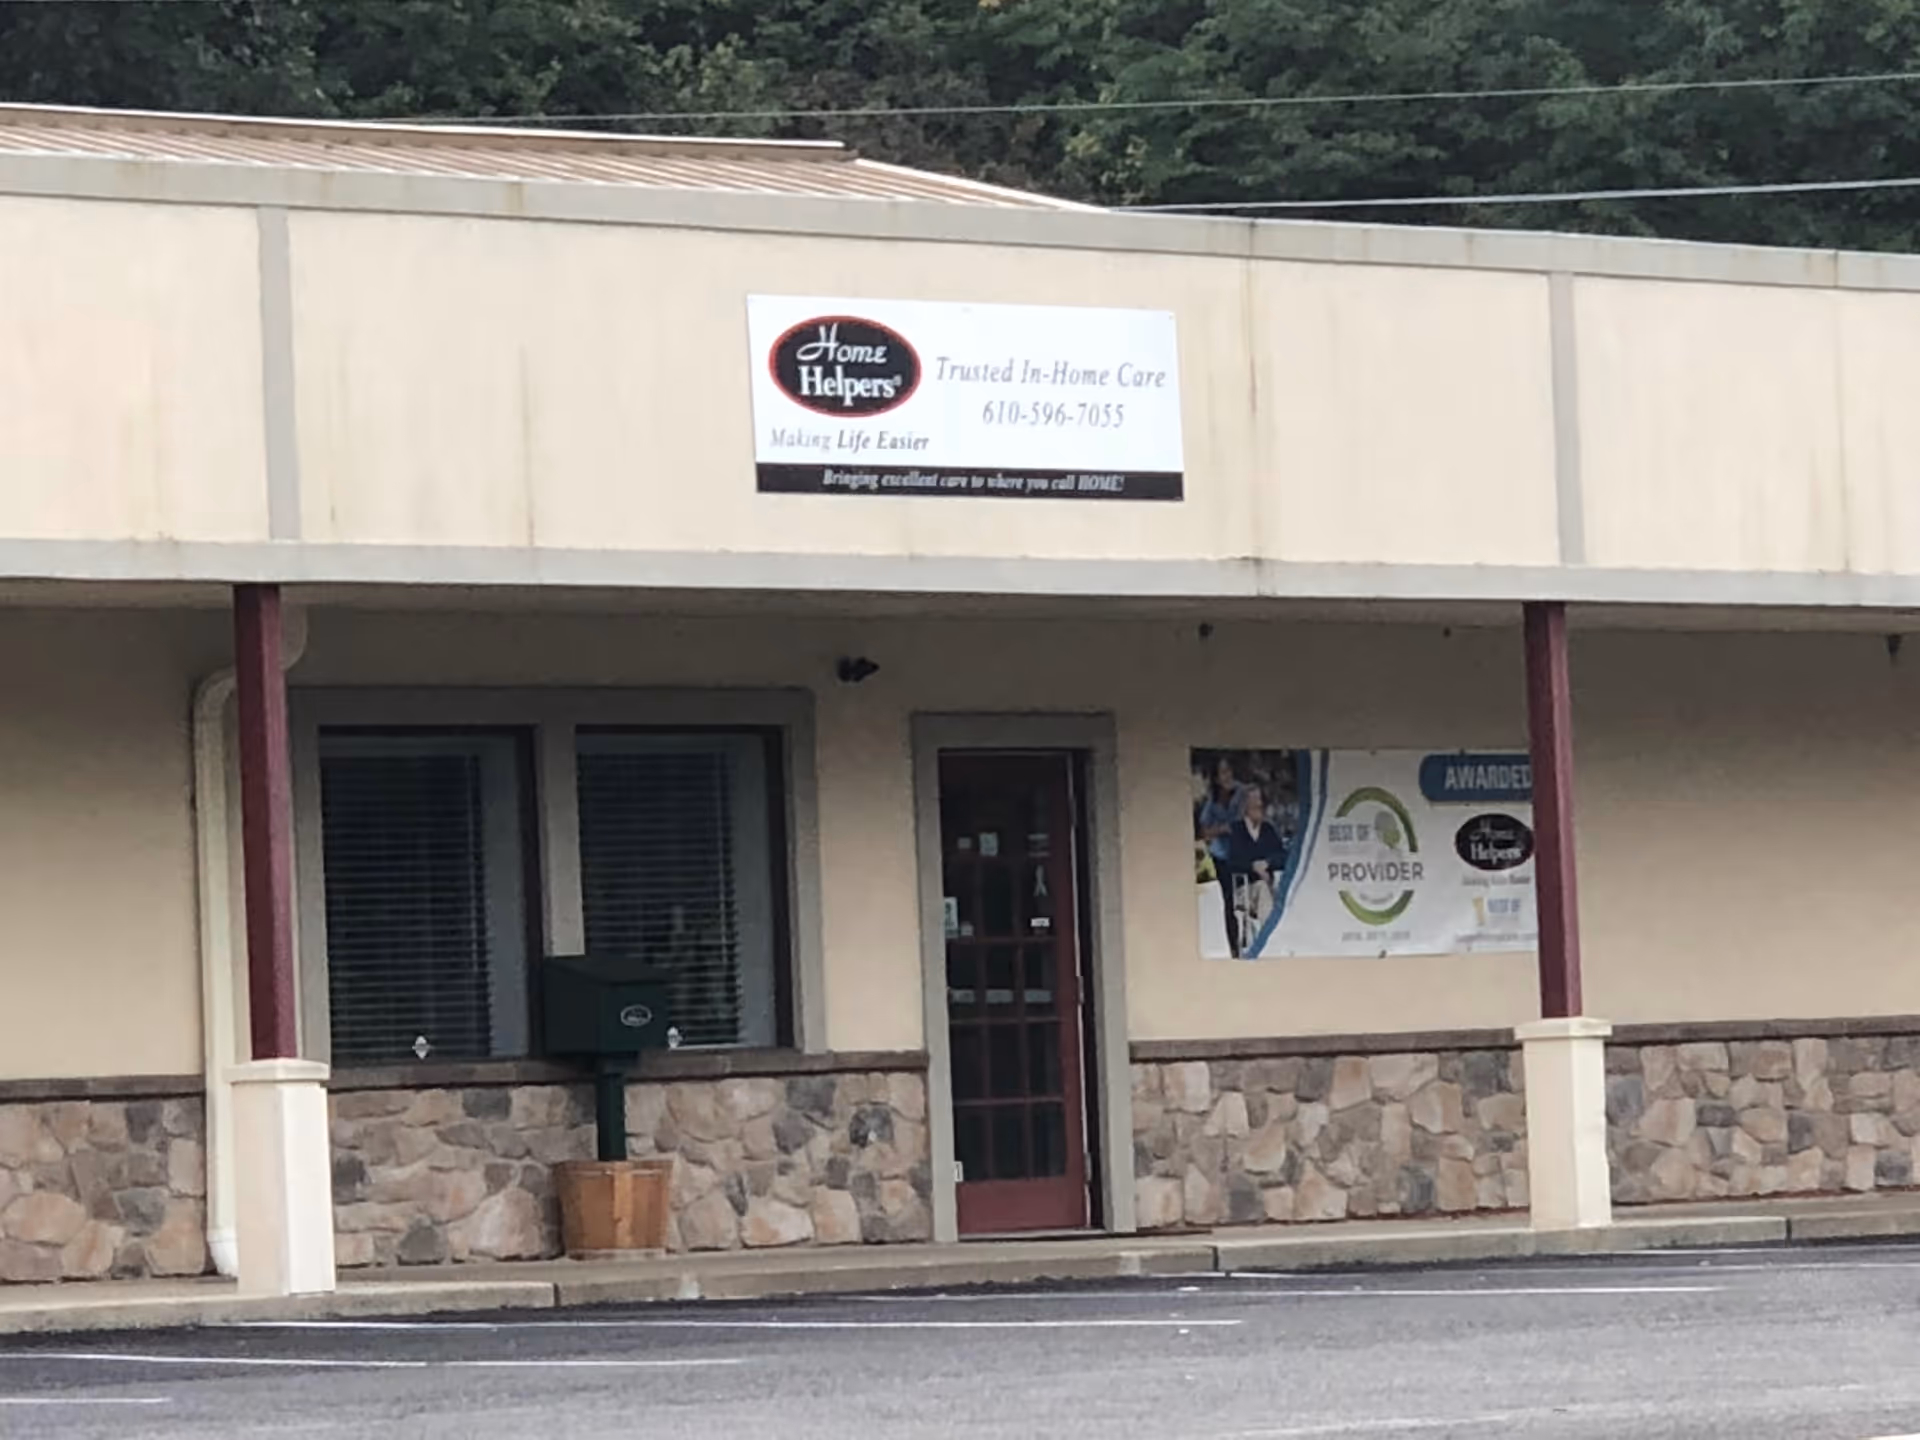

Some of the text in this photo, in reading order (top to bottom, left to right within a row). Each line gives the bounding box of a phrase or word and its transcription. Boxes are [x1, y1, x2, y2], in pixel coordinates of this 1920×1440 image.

[796, 322, 888, 364] Home
[937, 356, 1167, 388] Trusted In-Home Care
[982, 400, 1125, 428] 610-596-7055
[770, 428, 930, 454] Making Life Easier
[823, 468, 1126, 495] Bringing excellent care to where you call HOME!
[1444, 764, 1533, 790] AWARDED
[1328, 823, 1371, 843] BEST OF
[1327, 861, 1425, 882] PROVIDER
